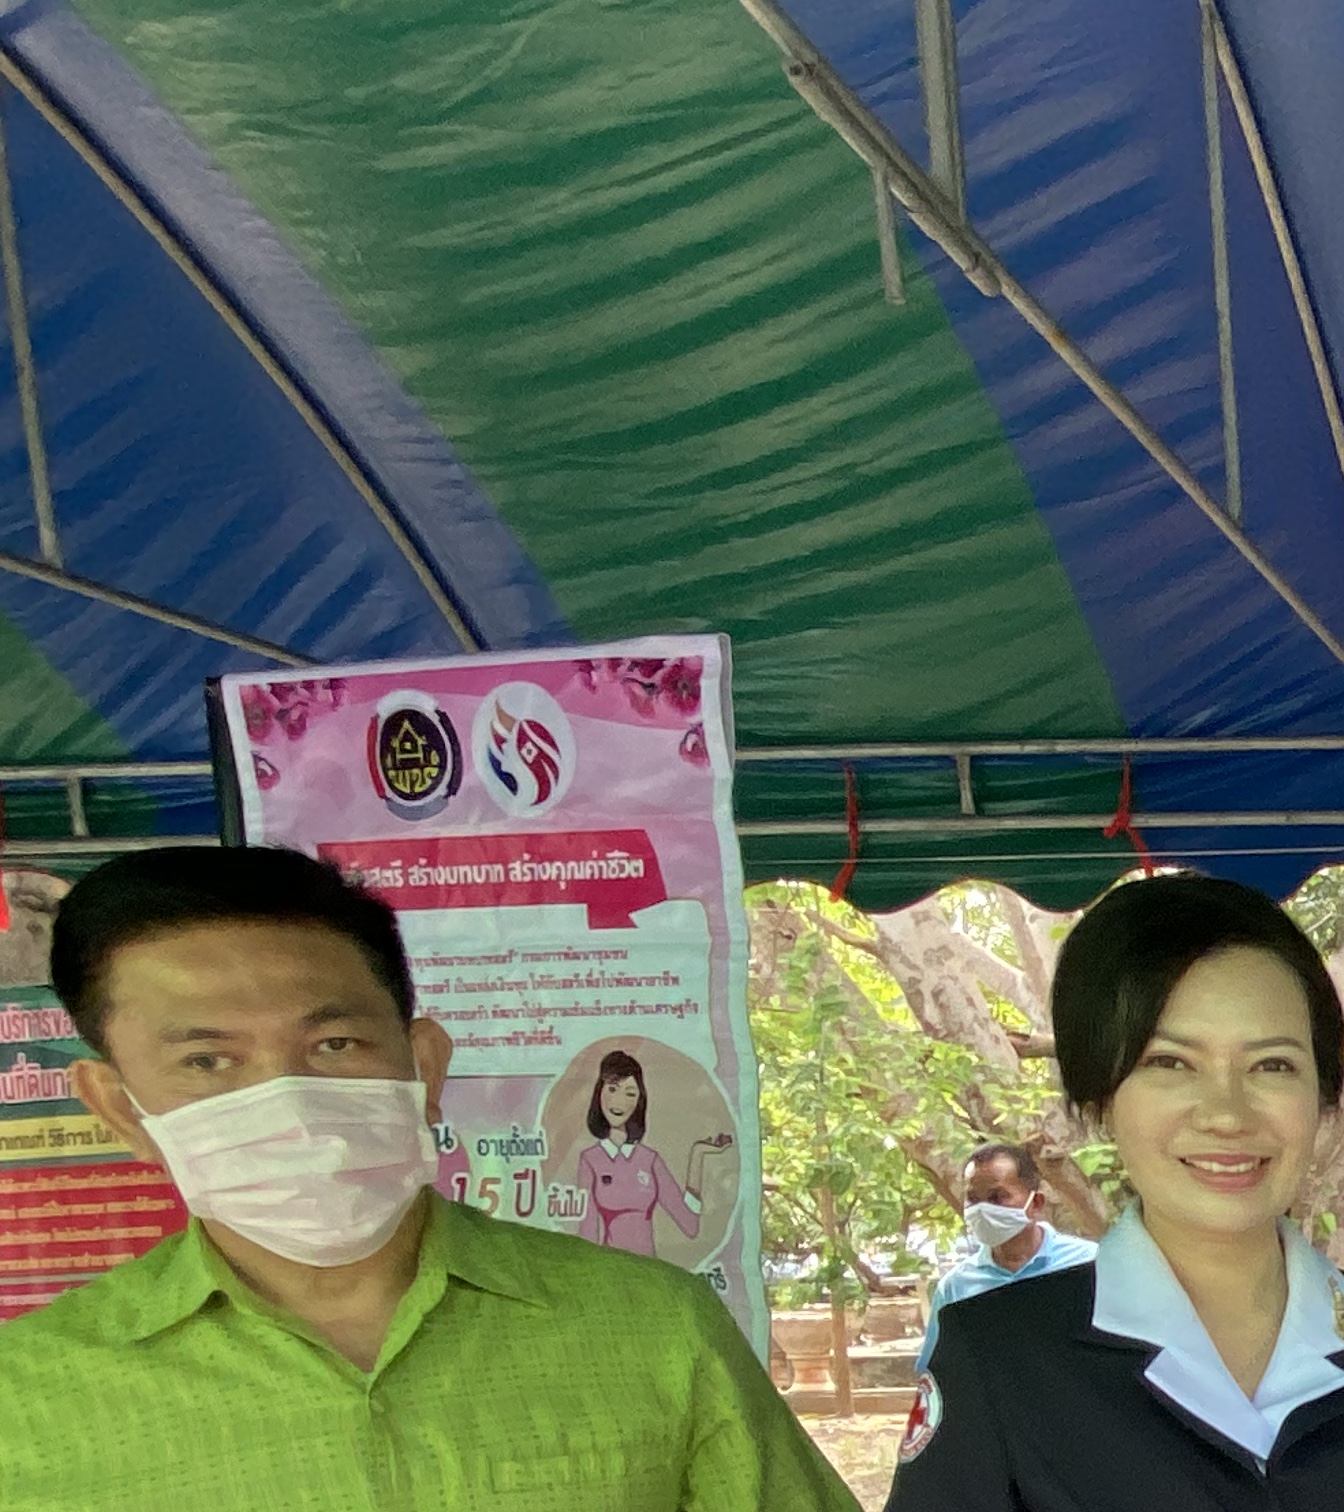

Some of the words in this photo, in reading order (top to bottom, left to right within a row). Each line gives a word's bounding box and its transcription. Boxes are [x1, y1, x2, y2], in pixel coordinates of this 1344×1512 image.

[408, 857, 505, 888] สร้างบทบาท
[507, 850, 645, 890] สร้างคุณค่าชีวิต
[477, 1126, 545, 1163] อายุตั้งแต่
[514, 1167, 537, 1217] ปี
[546, 1187, 584, 1218] ขึ้นไป
